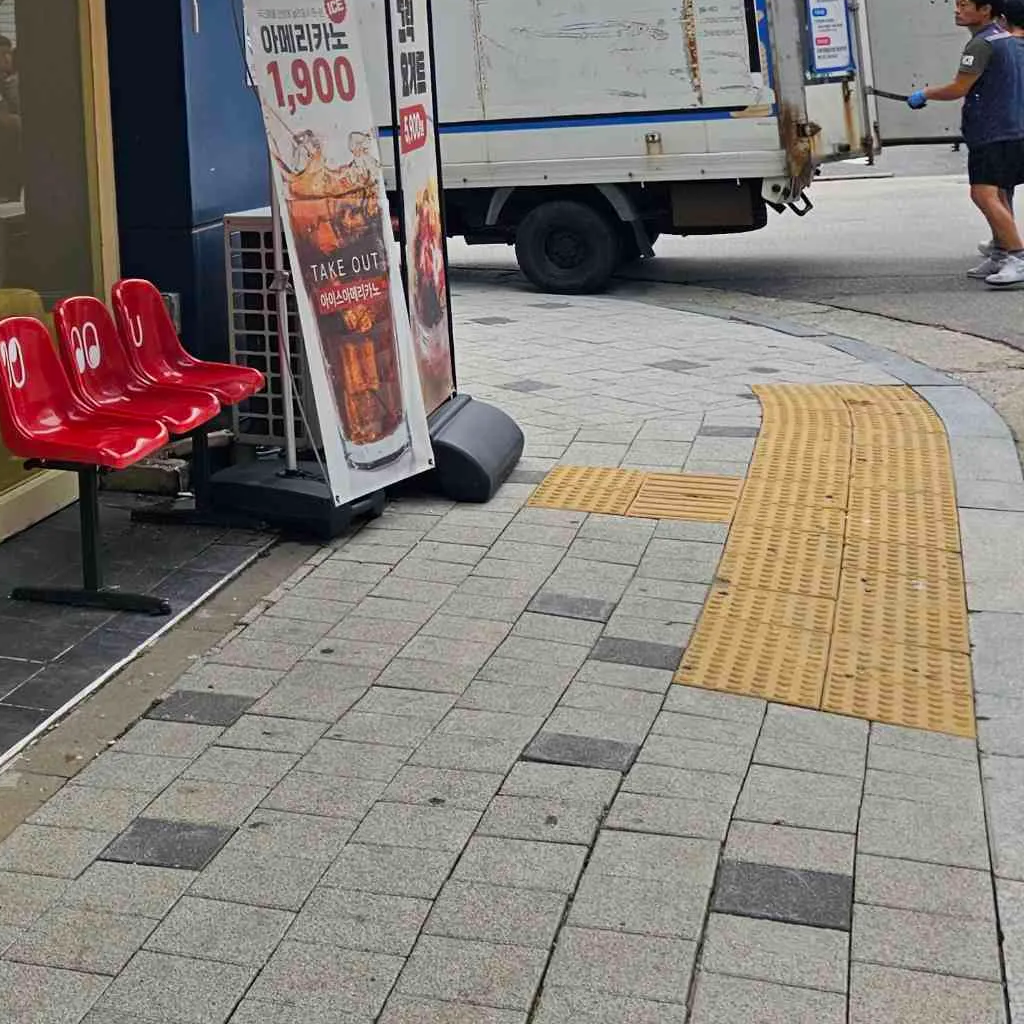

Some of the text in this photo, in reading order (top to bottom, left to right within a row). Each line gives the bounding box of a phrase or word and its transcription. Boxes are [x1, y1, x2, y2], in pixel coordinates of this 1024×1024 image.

[260, 22, 350, 55] 아메리카노
[266, 56, 356, 116] 1,900
[310, 252, 378, 282] TAKE OUT
[320, 282, 382, 309] 아이스아메리카노
